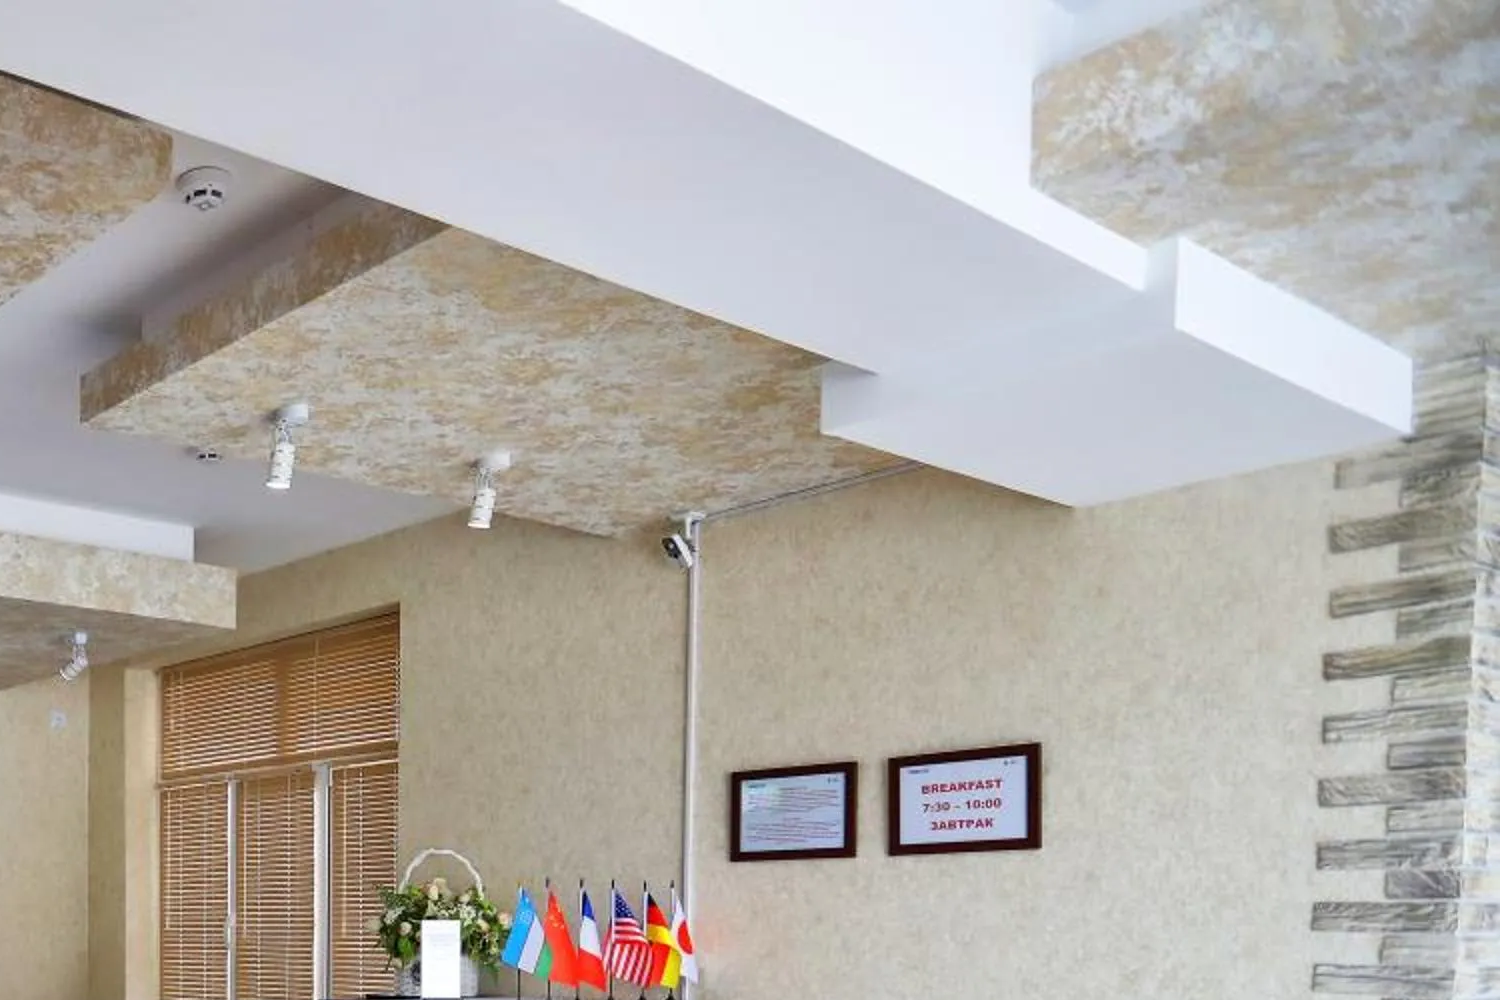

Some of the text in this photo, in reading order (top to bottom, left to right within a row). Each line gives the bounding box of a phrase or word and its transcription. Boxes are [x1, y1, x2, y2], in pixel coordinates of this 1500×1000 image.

[921, 778, 1003, 795] BREAKFAST
[922, 801, 950, 813] 7:30
[966, 797, 1002, 810] 10:00
[930, 817, 994, 831] ЗАВТРАК
